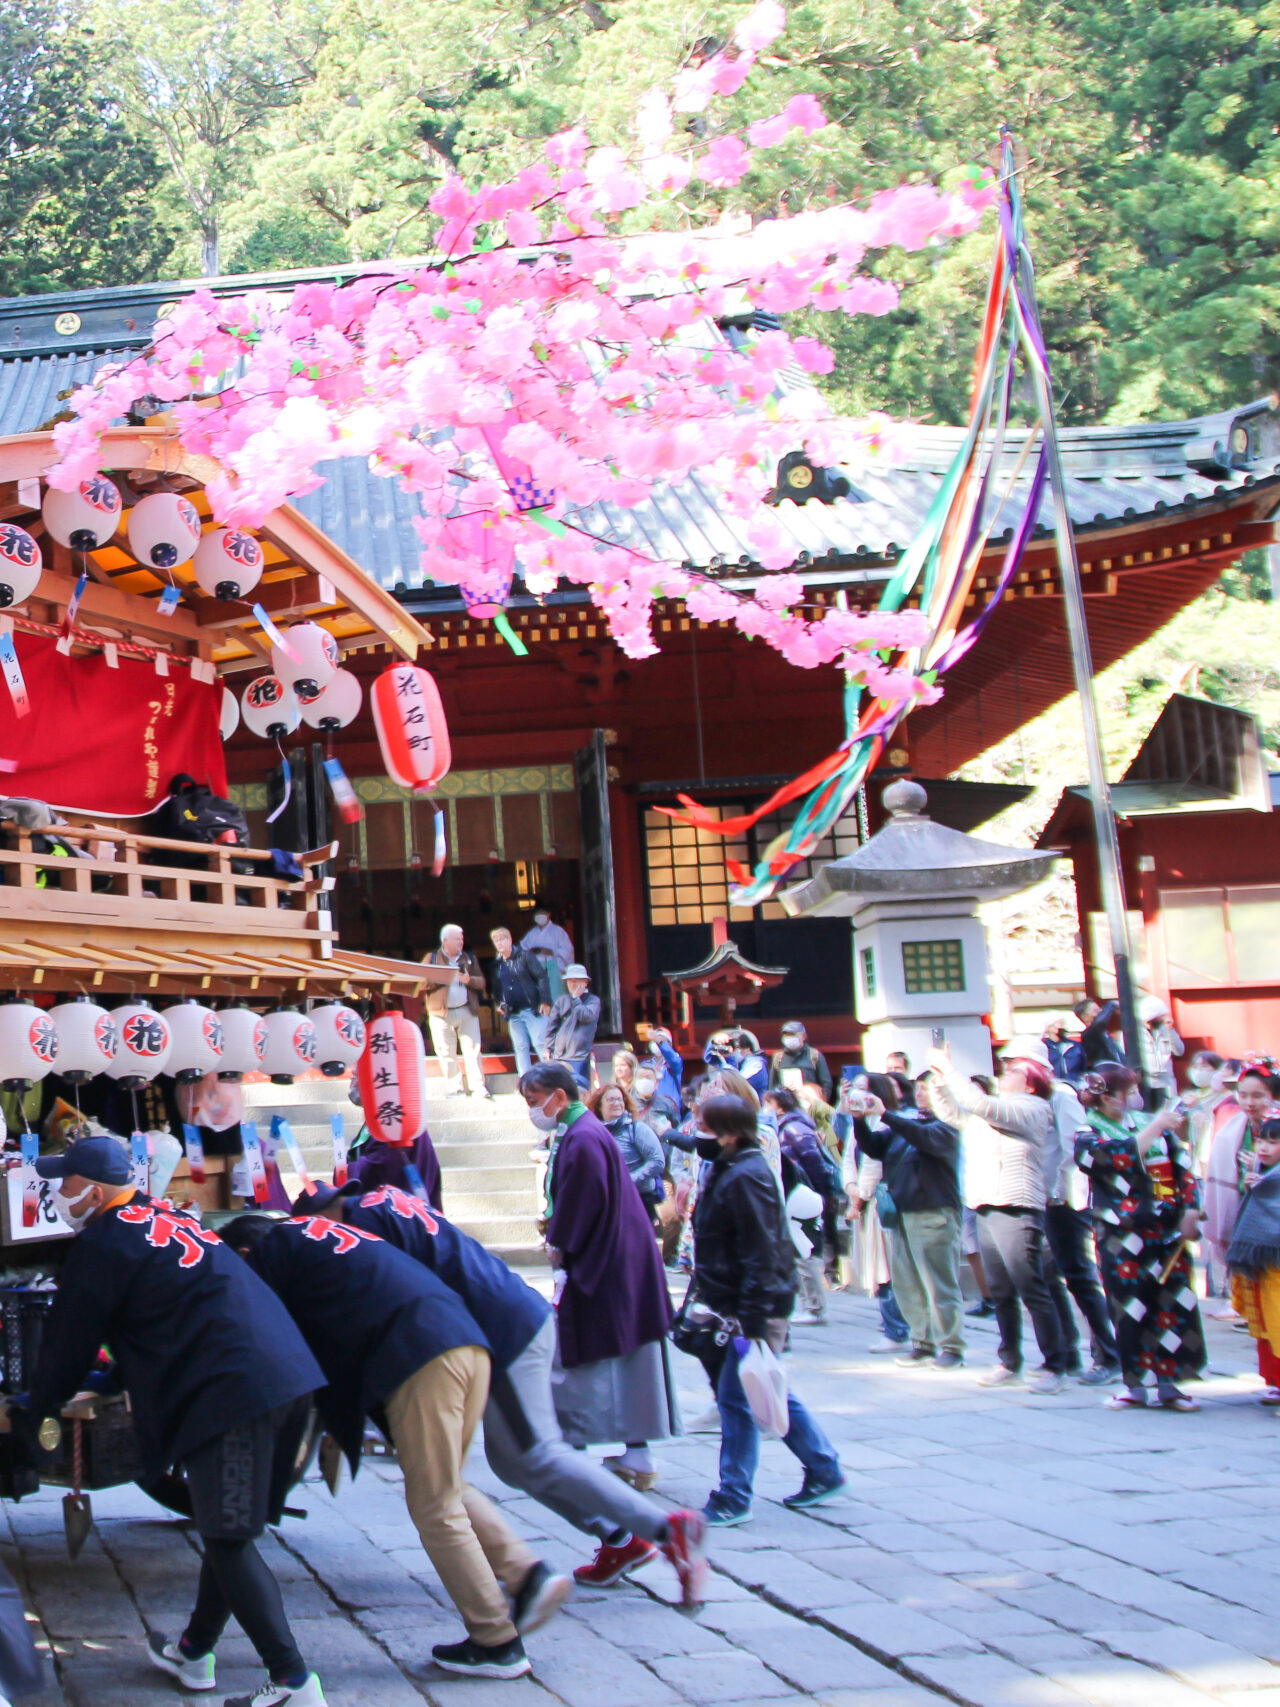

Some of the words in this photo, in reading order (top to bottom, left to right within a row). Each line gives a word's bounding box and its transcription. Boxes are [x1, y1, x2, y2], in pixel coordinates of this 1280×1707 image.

[229, 533, 259, 564] 花
[248, 679, 278, 705] 花
[396, 673, 433, 752] 花石町
[34, 1021, 59, 1059] 花
[128, 1017, 165, 1052] 花
[342, 1014, 364, 1046] 花
[370, 1032, 407, 1127] 弥生祭
